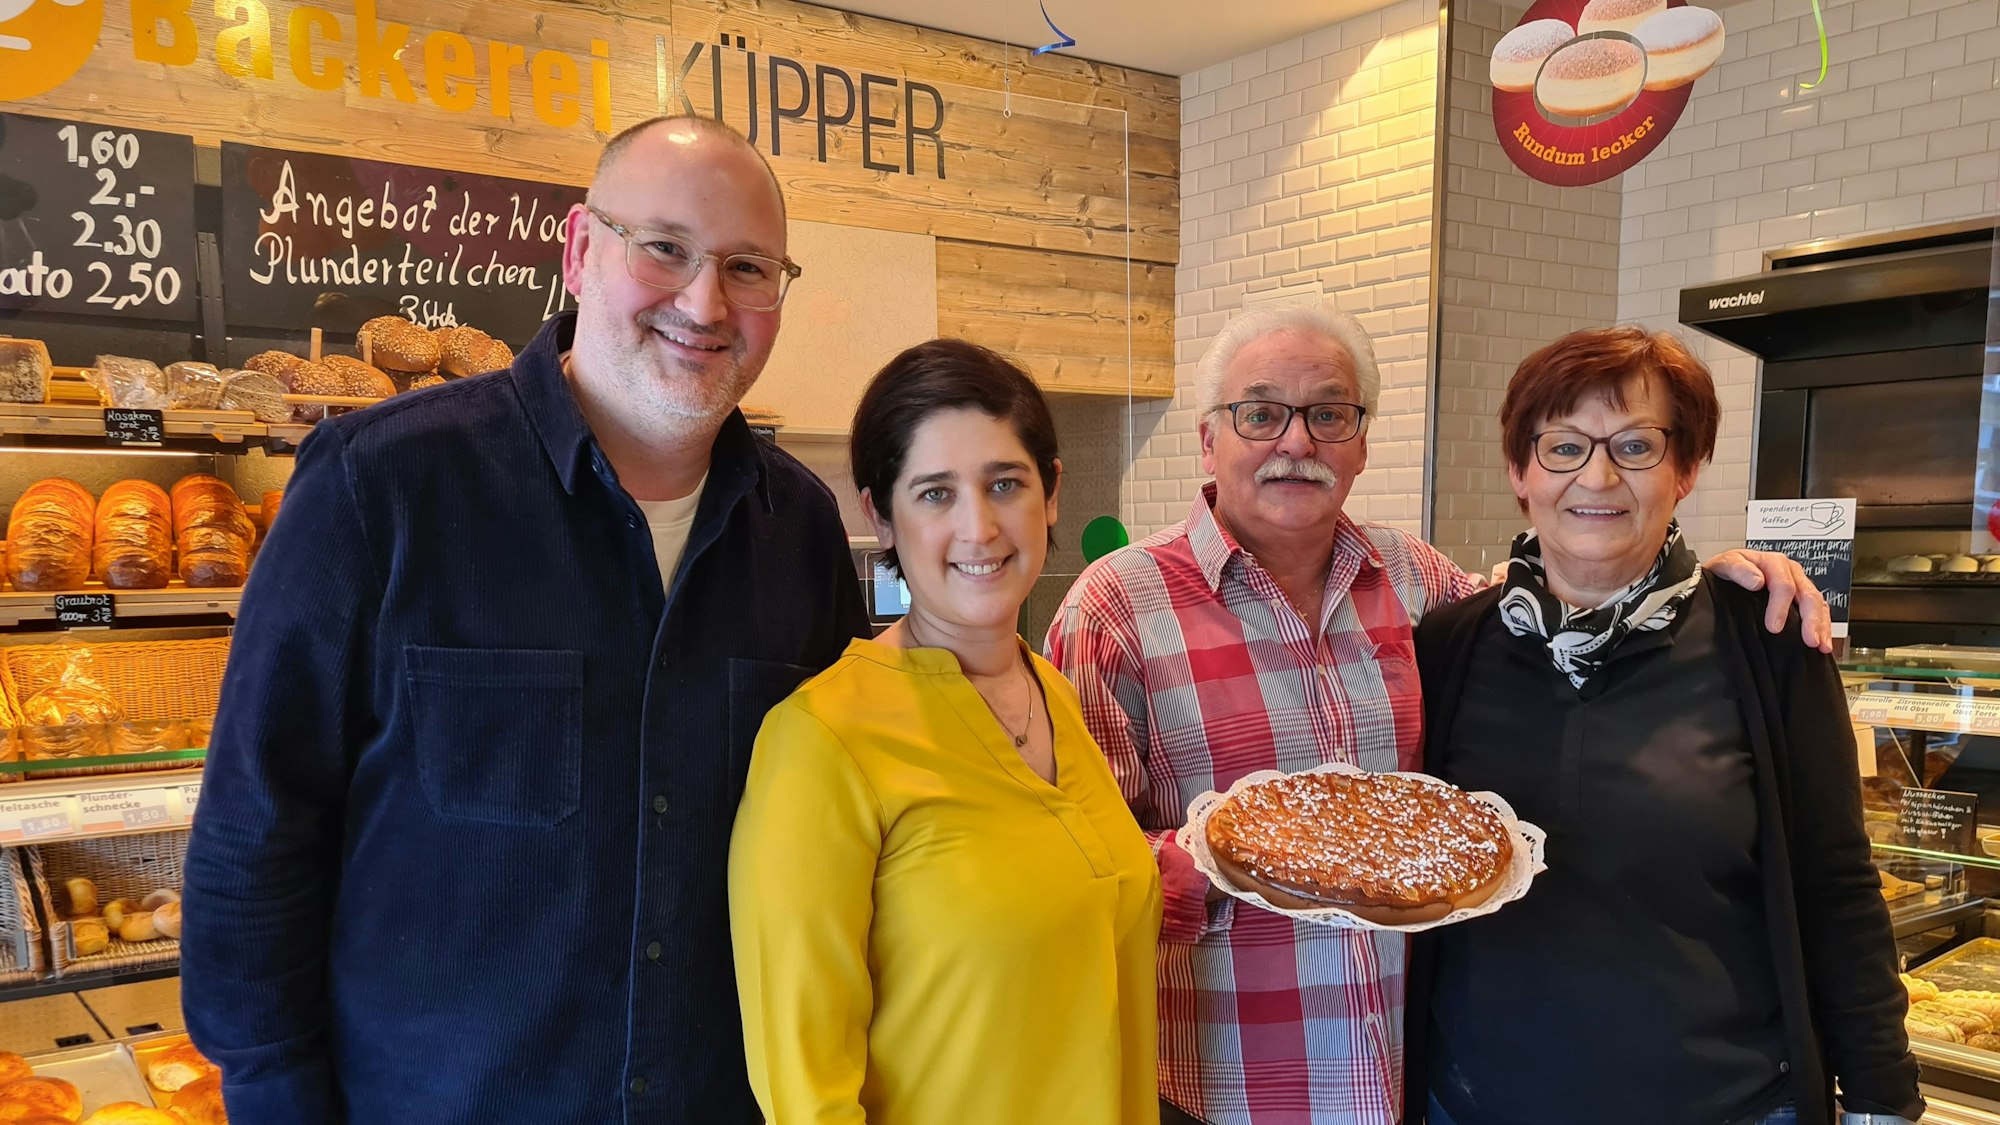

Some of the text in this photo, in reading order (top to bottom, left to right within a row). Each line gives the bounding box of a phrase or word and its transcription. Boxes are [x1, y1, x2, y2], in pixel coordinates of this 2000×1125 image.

[655, 33, 946, 180] KÜPPER
[1513, 115, 1656, 166] Rundum lecker
[58, 125, 140, 169] 1.60
[259, 159, 437, 239] Angebot
[449, 191, 500, 236] der
[71, 211, 162, 259] 2.30
[0, 251, 181, 310] ato 2,50
[1708, 290, 1765, 310] wachtel
[1760, 505, 1809, 514] spendierter
[1761, 516, 1789, 524] Kaffee
[1747, 541, 1773, 551] Kaffee
[56, 595, 111, 610] Graubrot
[1897, 699, 1951, 708] Zitronenrolle
[1955, 702, 2000, 711] Gemischte
[1953, 708, 1973, 716] Obst
[81, 792, 132, 803] Plunder-
[1902, 789, 1946, 800] Nussecken
[83, 800, 141, 813] schnecke
[1901, 816, 1914, 824] mit
